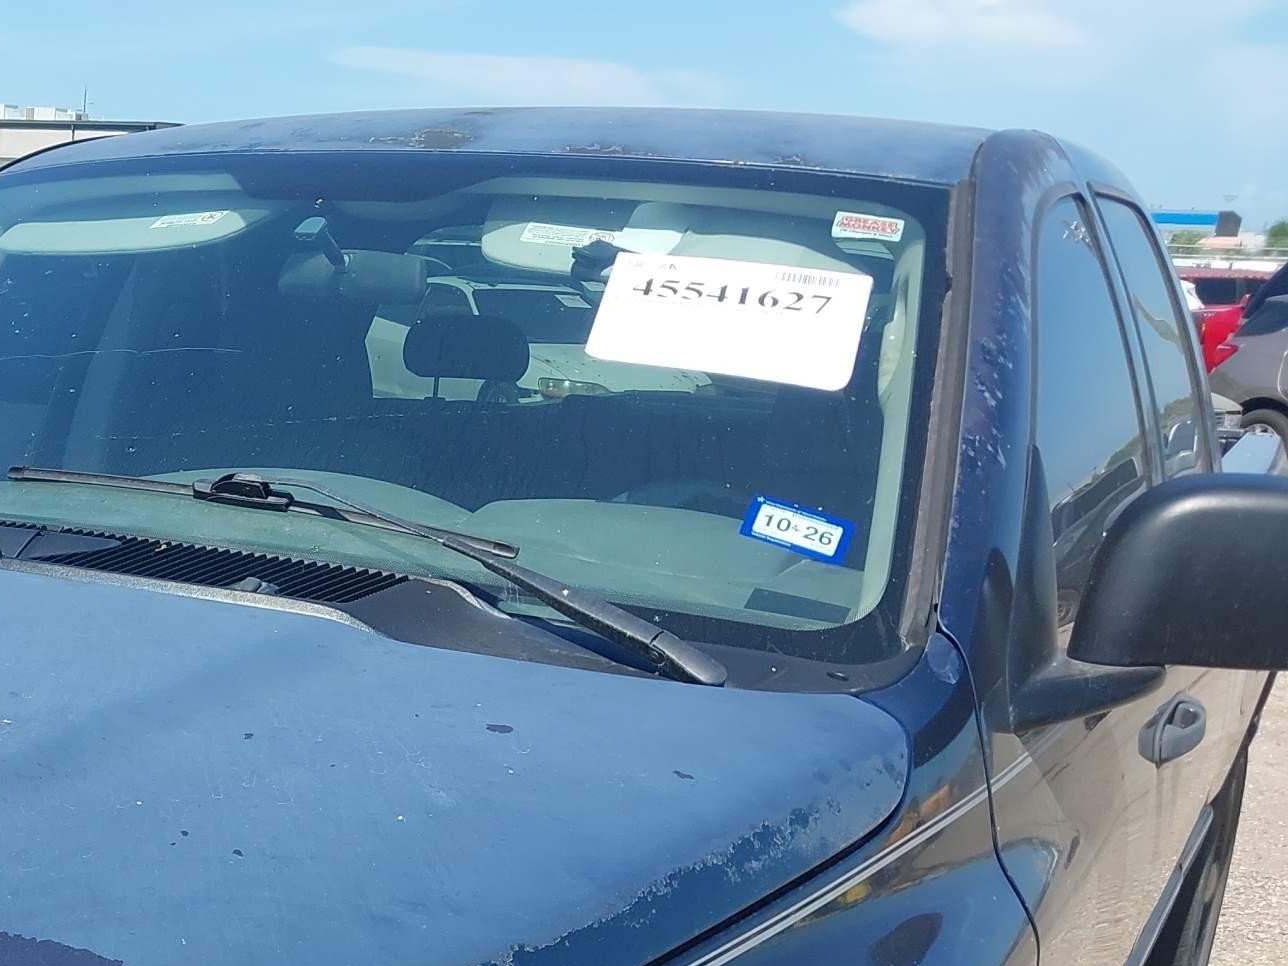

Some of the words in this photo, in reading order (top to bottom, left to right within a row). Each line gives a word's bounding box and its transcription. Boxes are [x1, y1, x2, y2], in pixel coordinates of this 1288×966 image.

[632, 278, 833, 314] 45541627
[765, 514, 792, 532] 10
[803, 526, 834, 546] 26
